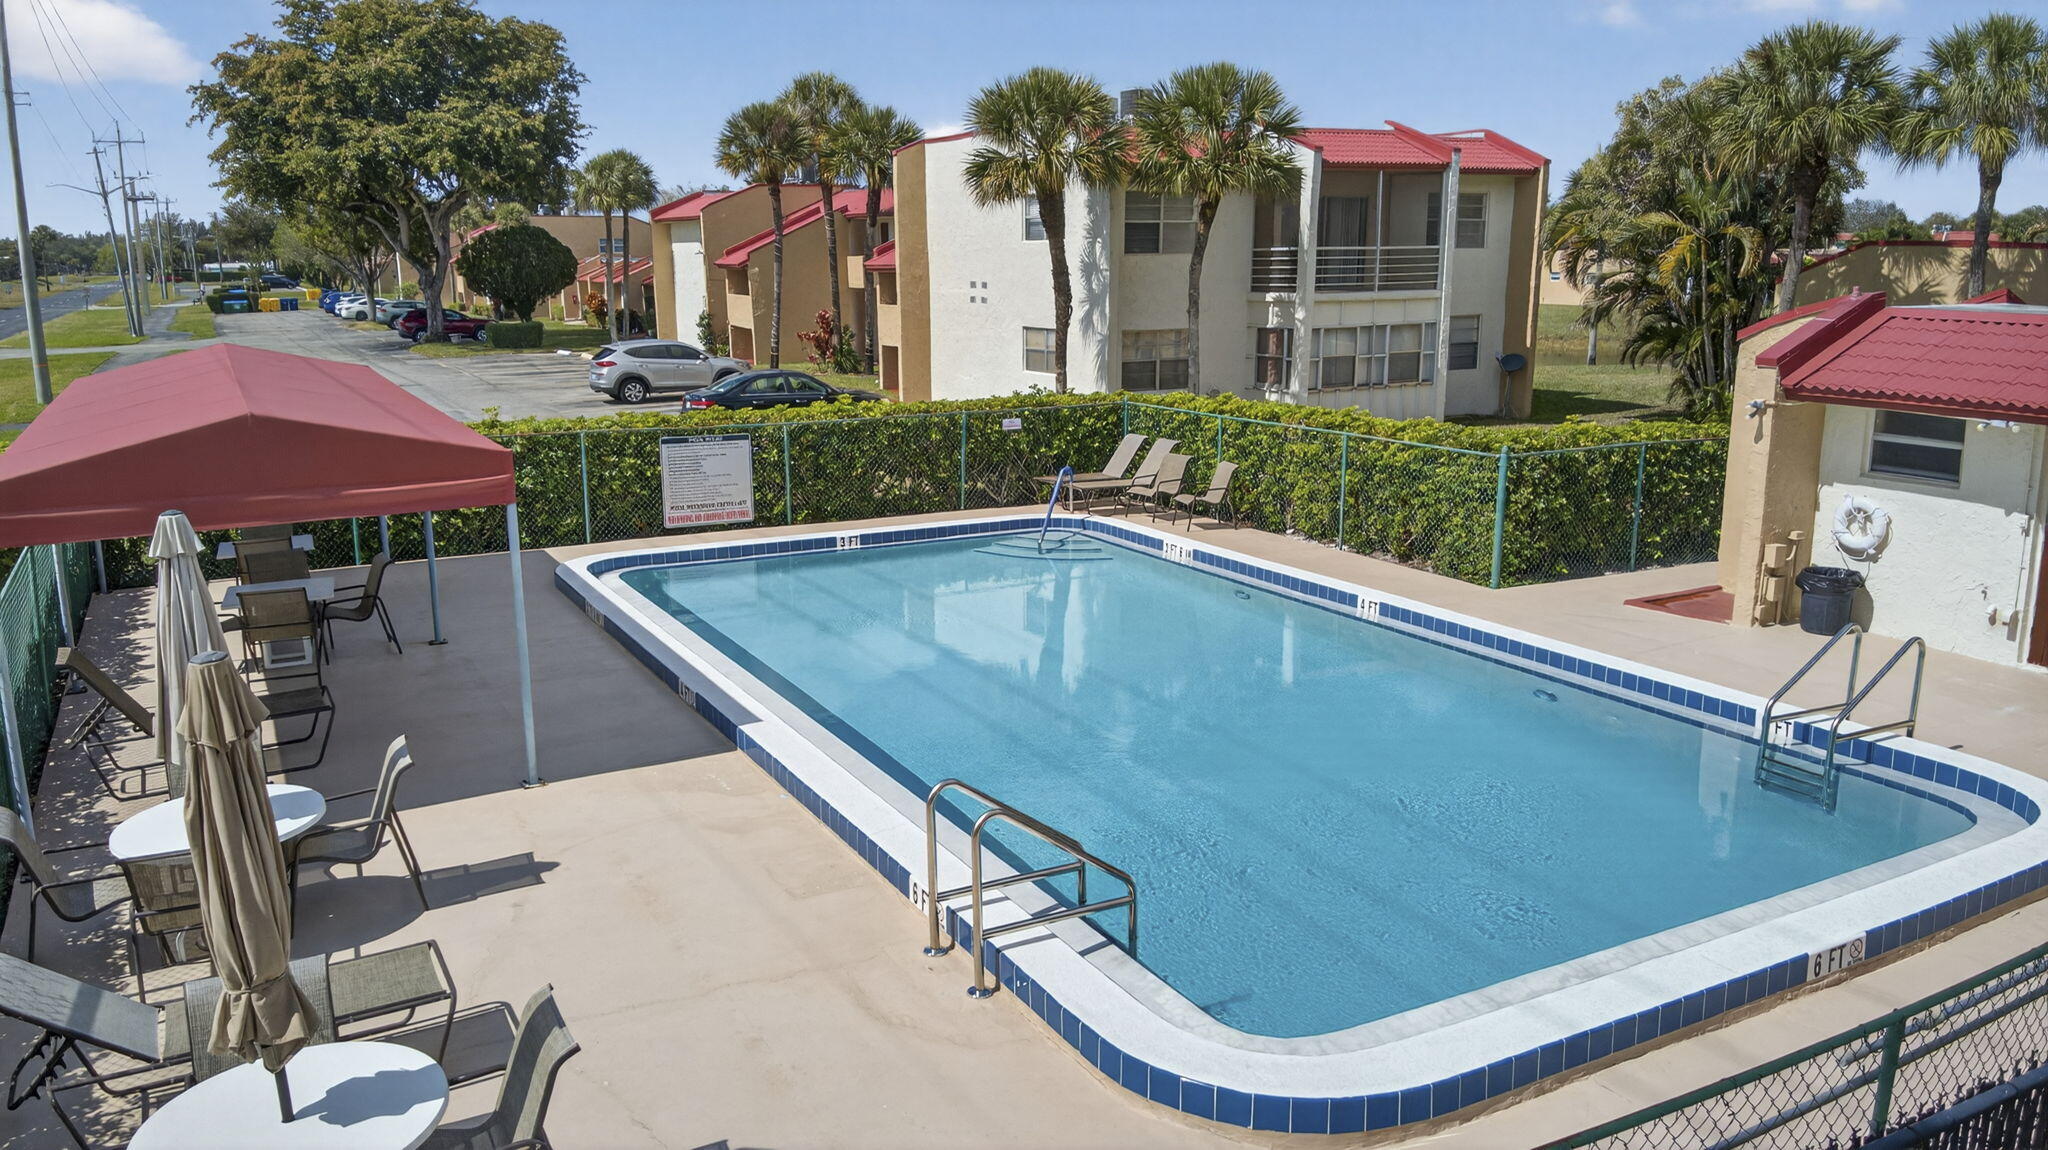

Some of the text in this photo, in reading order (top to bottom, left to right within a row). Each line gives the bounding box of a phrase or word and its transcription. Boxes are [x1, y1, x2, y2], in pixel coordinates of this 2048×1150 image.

[840, 535, 859, 548] 3 FT
[1368, 600, 1378, 615] FT
[912, 881, 919, 905] 6
[1813, 943, 1848, 978] 6 FT
